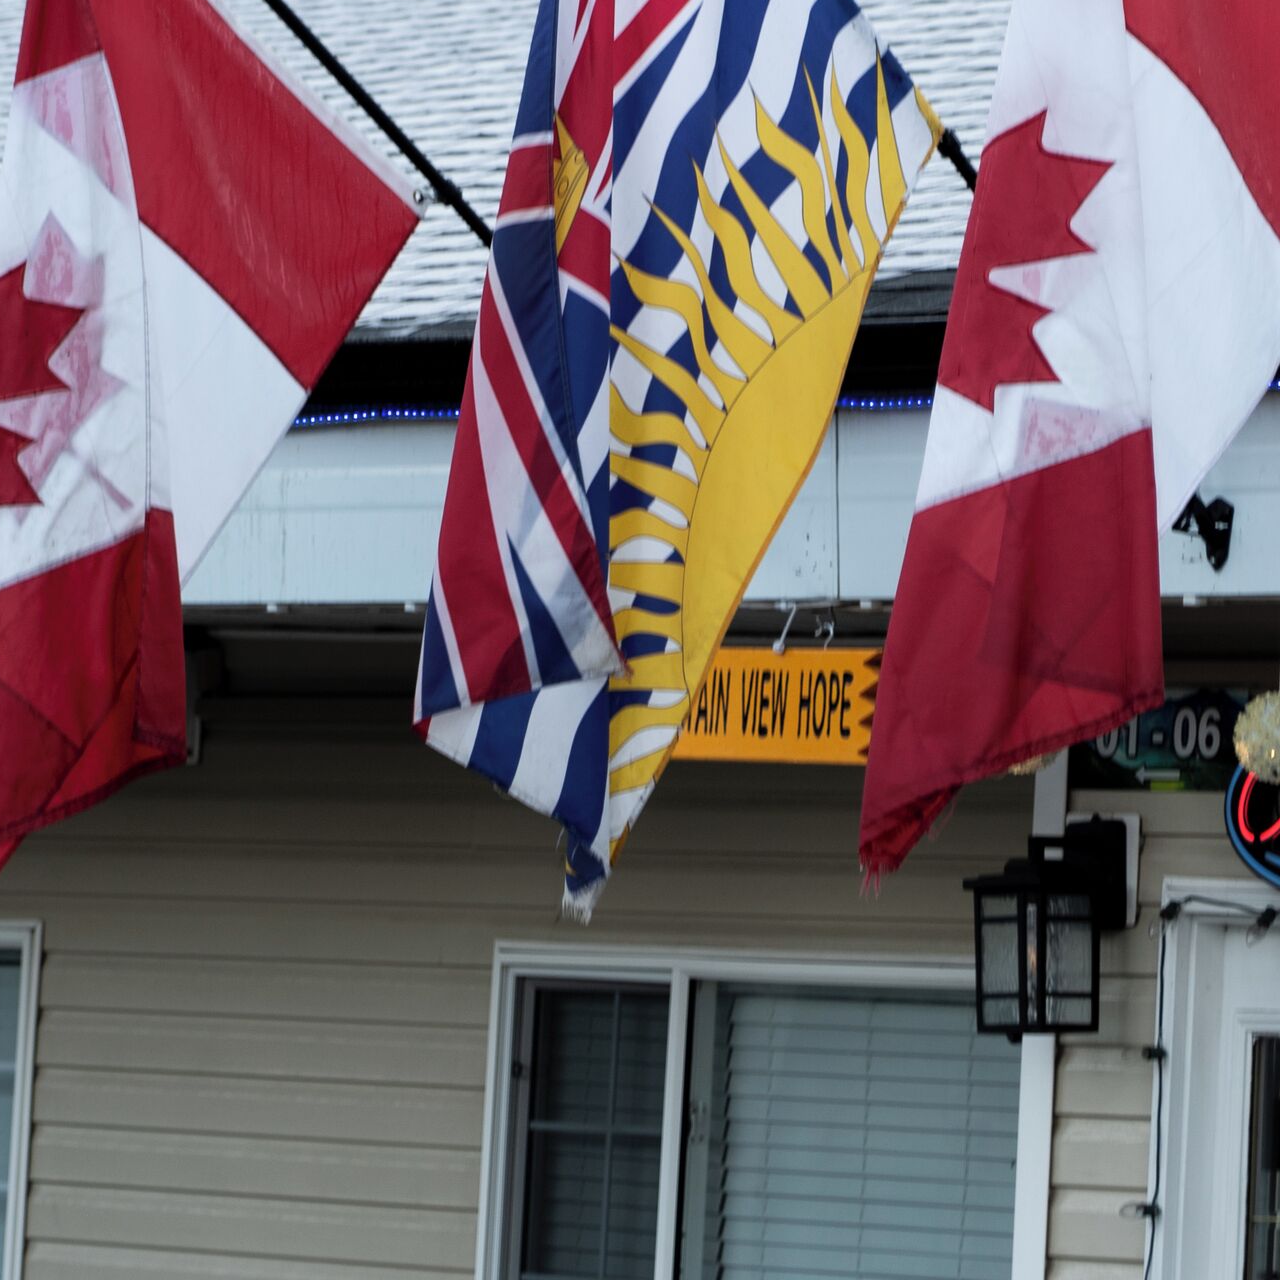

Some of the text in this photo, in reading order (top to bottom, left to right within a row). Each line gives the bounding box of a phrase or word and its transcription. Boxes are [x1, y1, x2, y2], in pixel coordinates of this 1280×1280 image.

[687, 669, 853, 739] AIN VIEW HOPE
